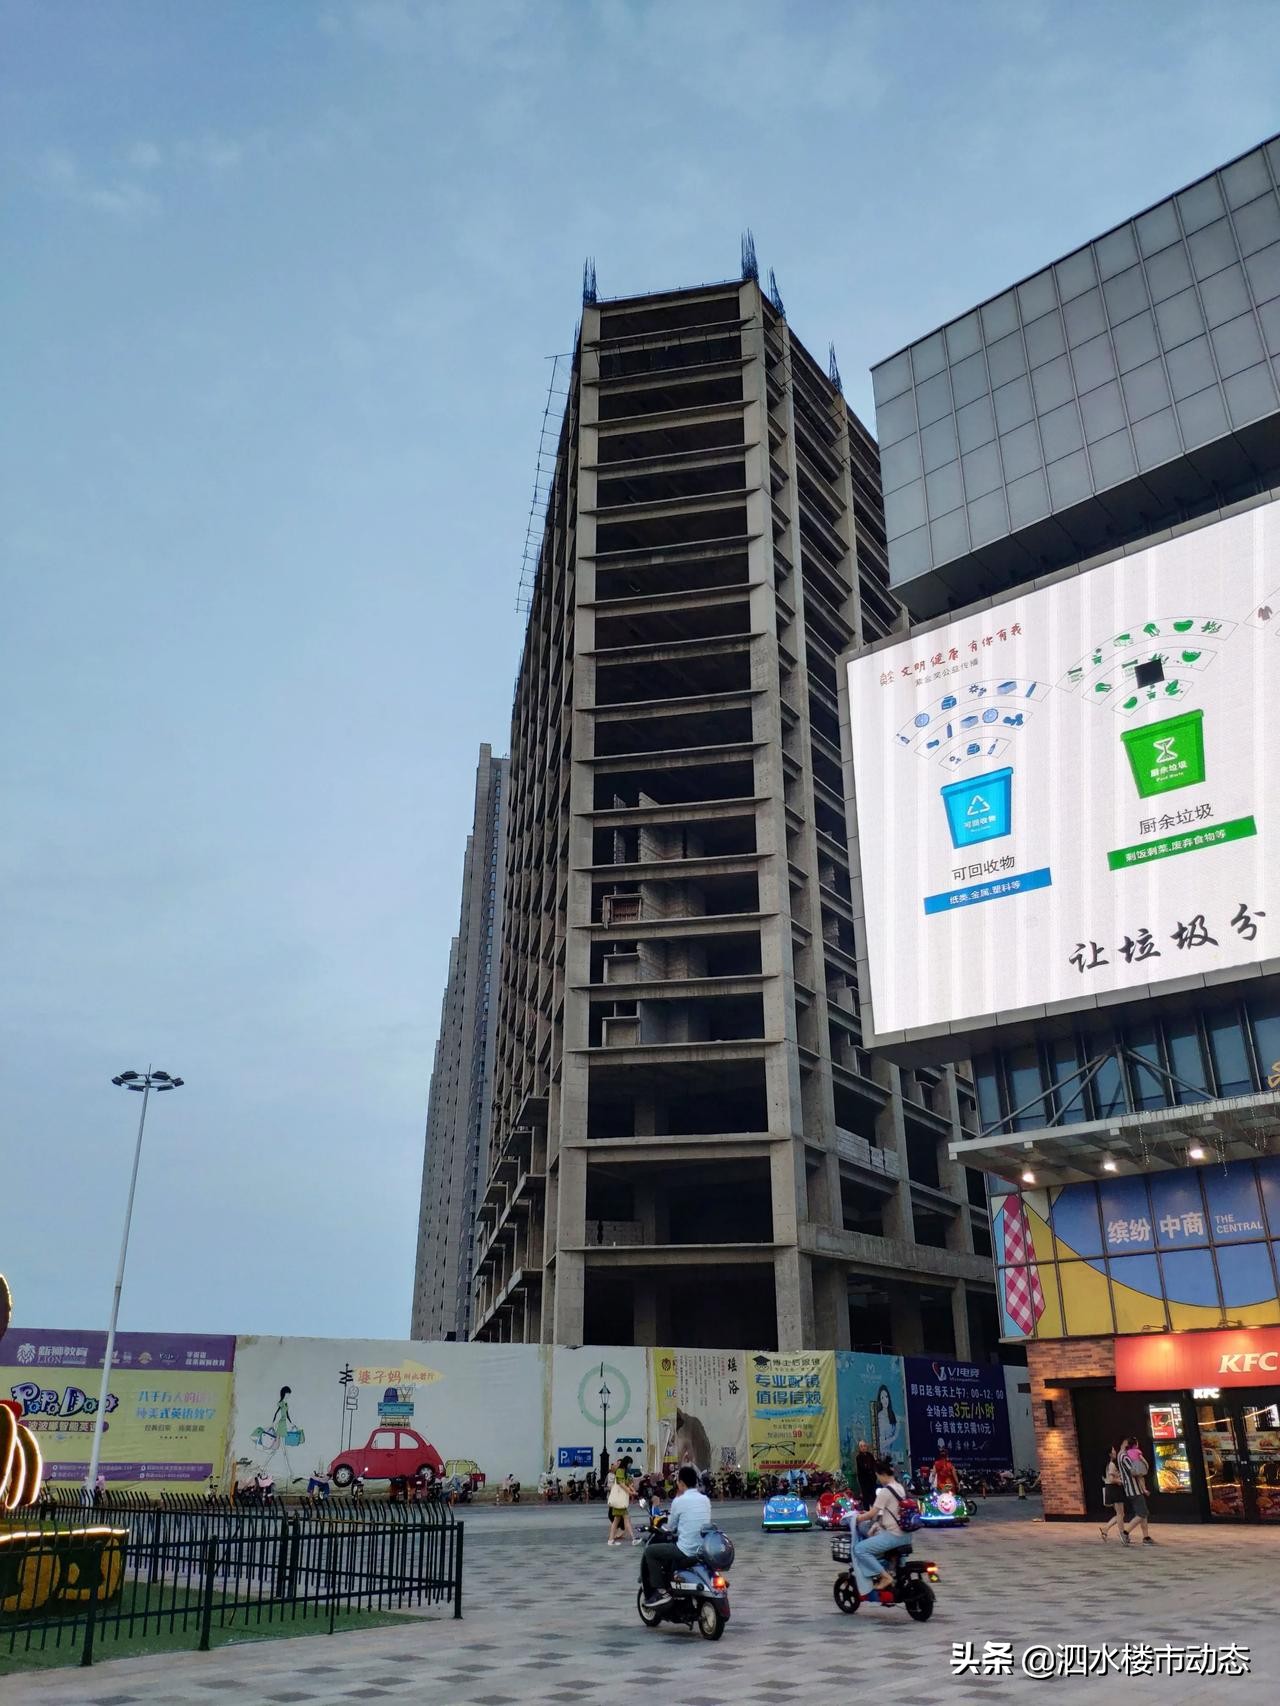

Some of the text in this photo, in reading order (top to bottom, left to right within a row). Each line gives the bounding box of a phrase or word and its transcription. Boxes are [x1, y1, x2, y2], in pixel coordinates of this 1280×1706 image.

[901, 623, 1022, 677] 文明健康 有你有我
[1139, 803, 1214, 835] 厨余垃圾
[951, 855, 1015, 881] 可回收物
[1214, 1214, 1235, 1224] THE
[1107, 1211, 1204, 1244] 缤纷 中商
[1216, 1220, 1264, 1234] CENTRAL
[1218, 1352, 1279, 1373] KFC
[755, 1373, 820, 1388] 专业配镜
[756, 1390, 822, 1405] 值得信赖
[1193, 1388, 1220, 1399] KFC
[560, 1451, 568, 1464] P
